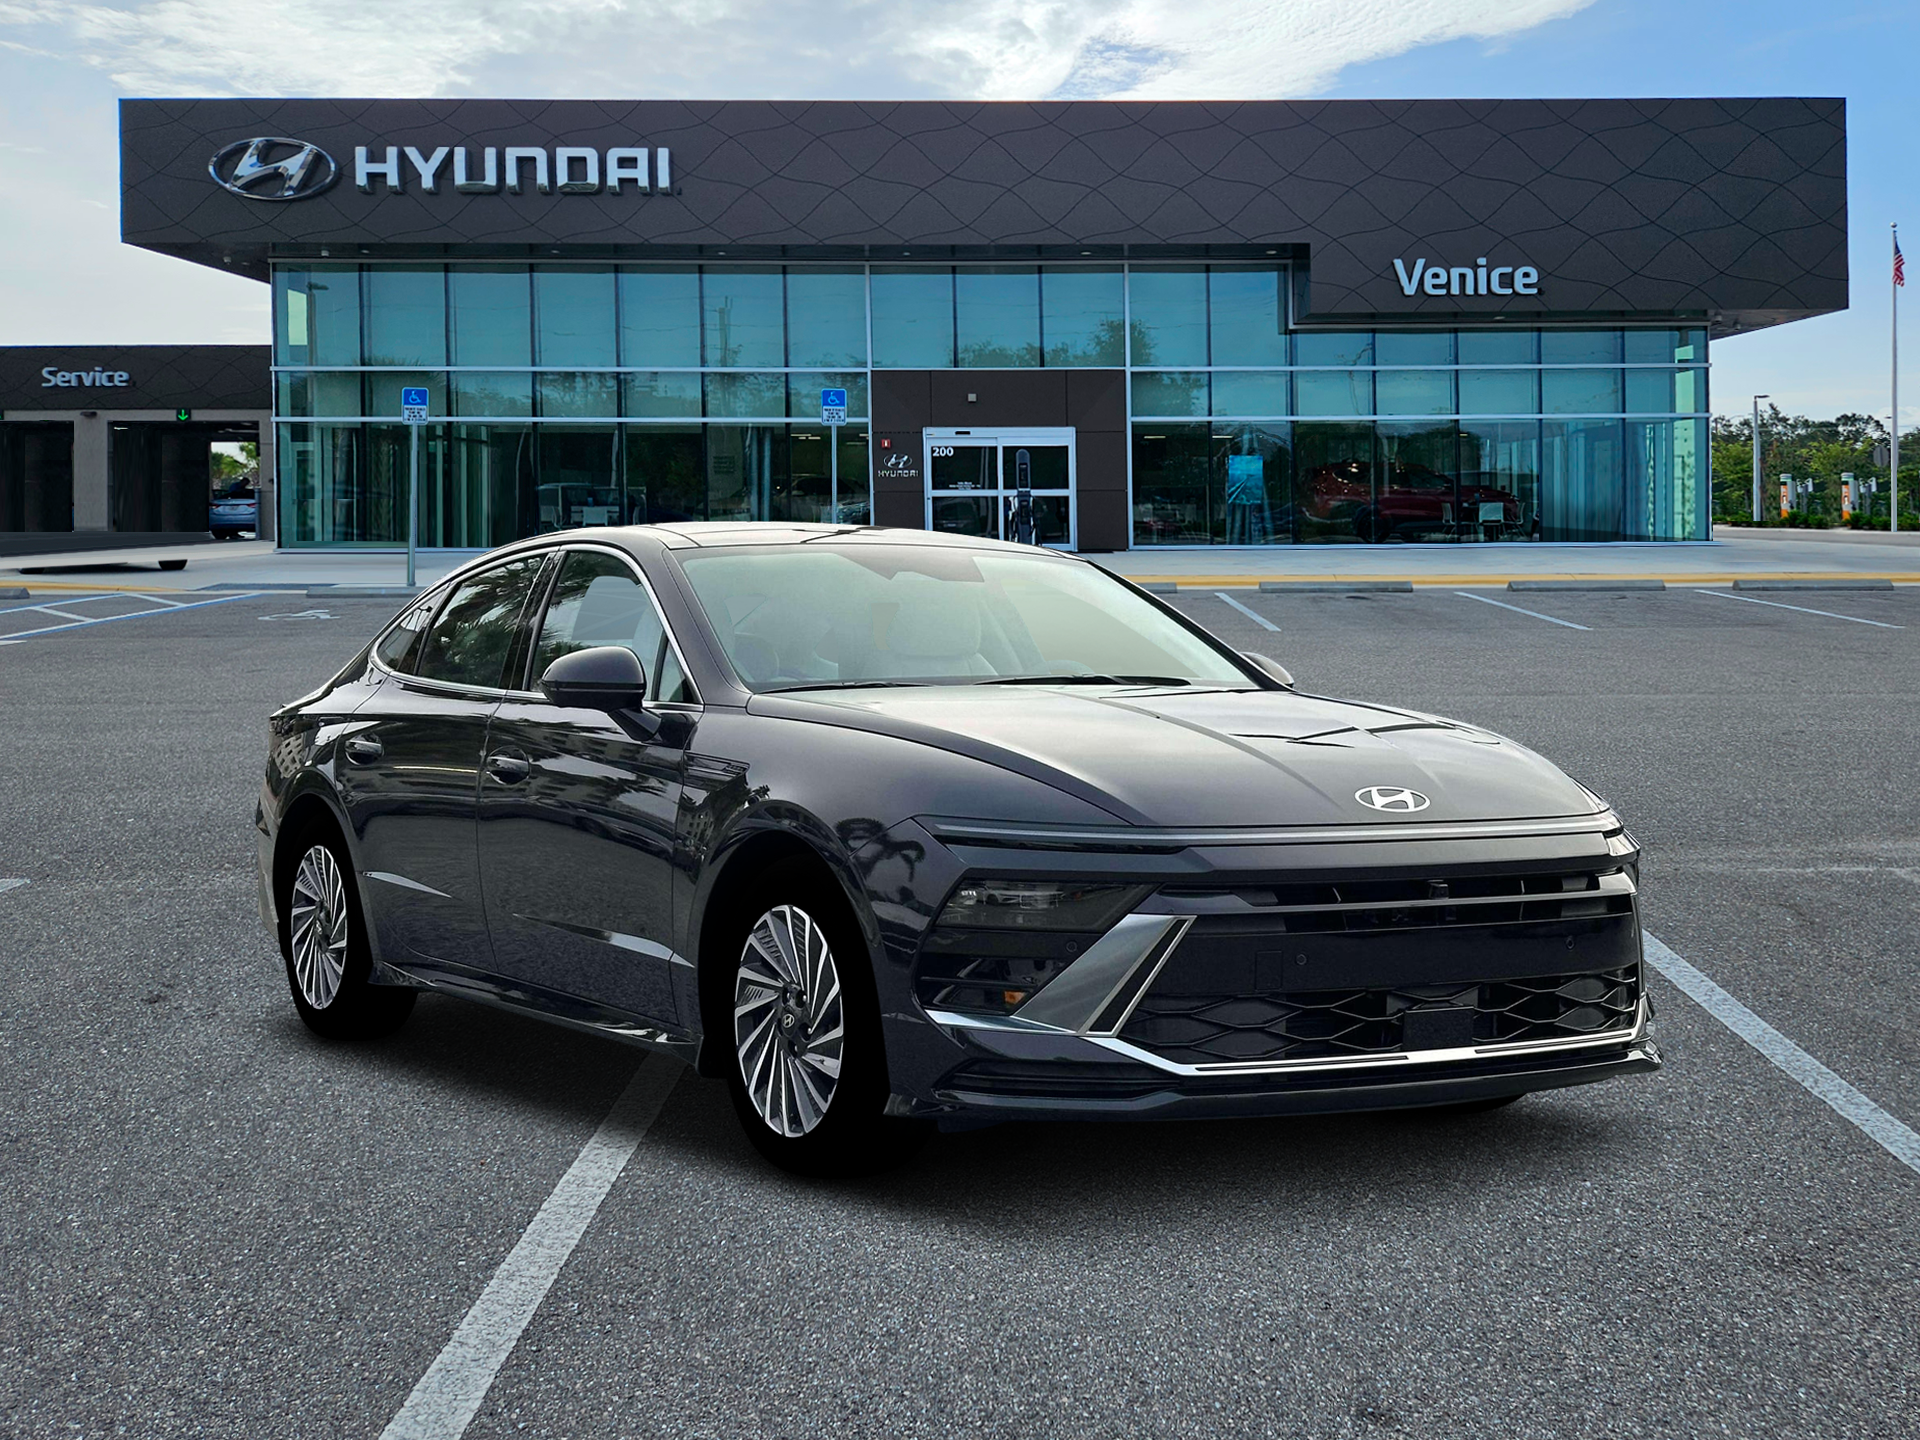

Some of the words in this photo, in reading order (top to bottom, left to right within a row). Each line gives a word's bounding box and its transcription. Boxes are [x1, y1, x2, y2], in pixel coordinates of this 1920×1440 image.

[354, 146, 671, 194] HYUNDAI
[1392, 257, 1539, 296] Venice
[41, 366, 130, 387] Service
[932, 446, 954, 457] 200
[877, 470, 919, 478] HYUNDAI
